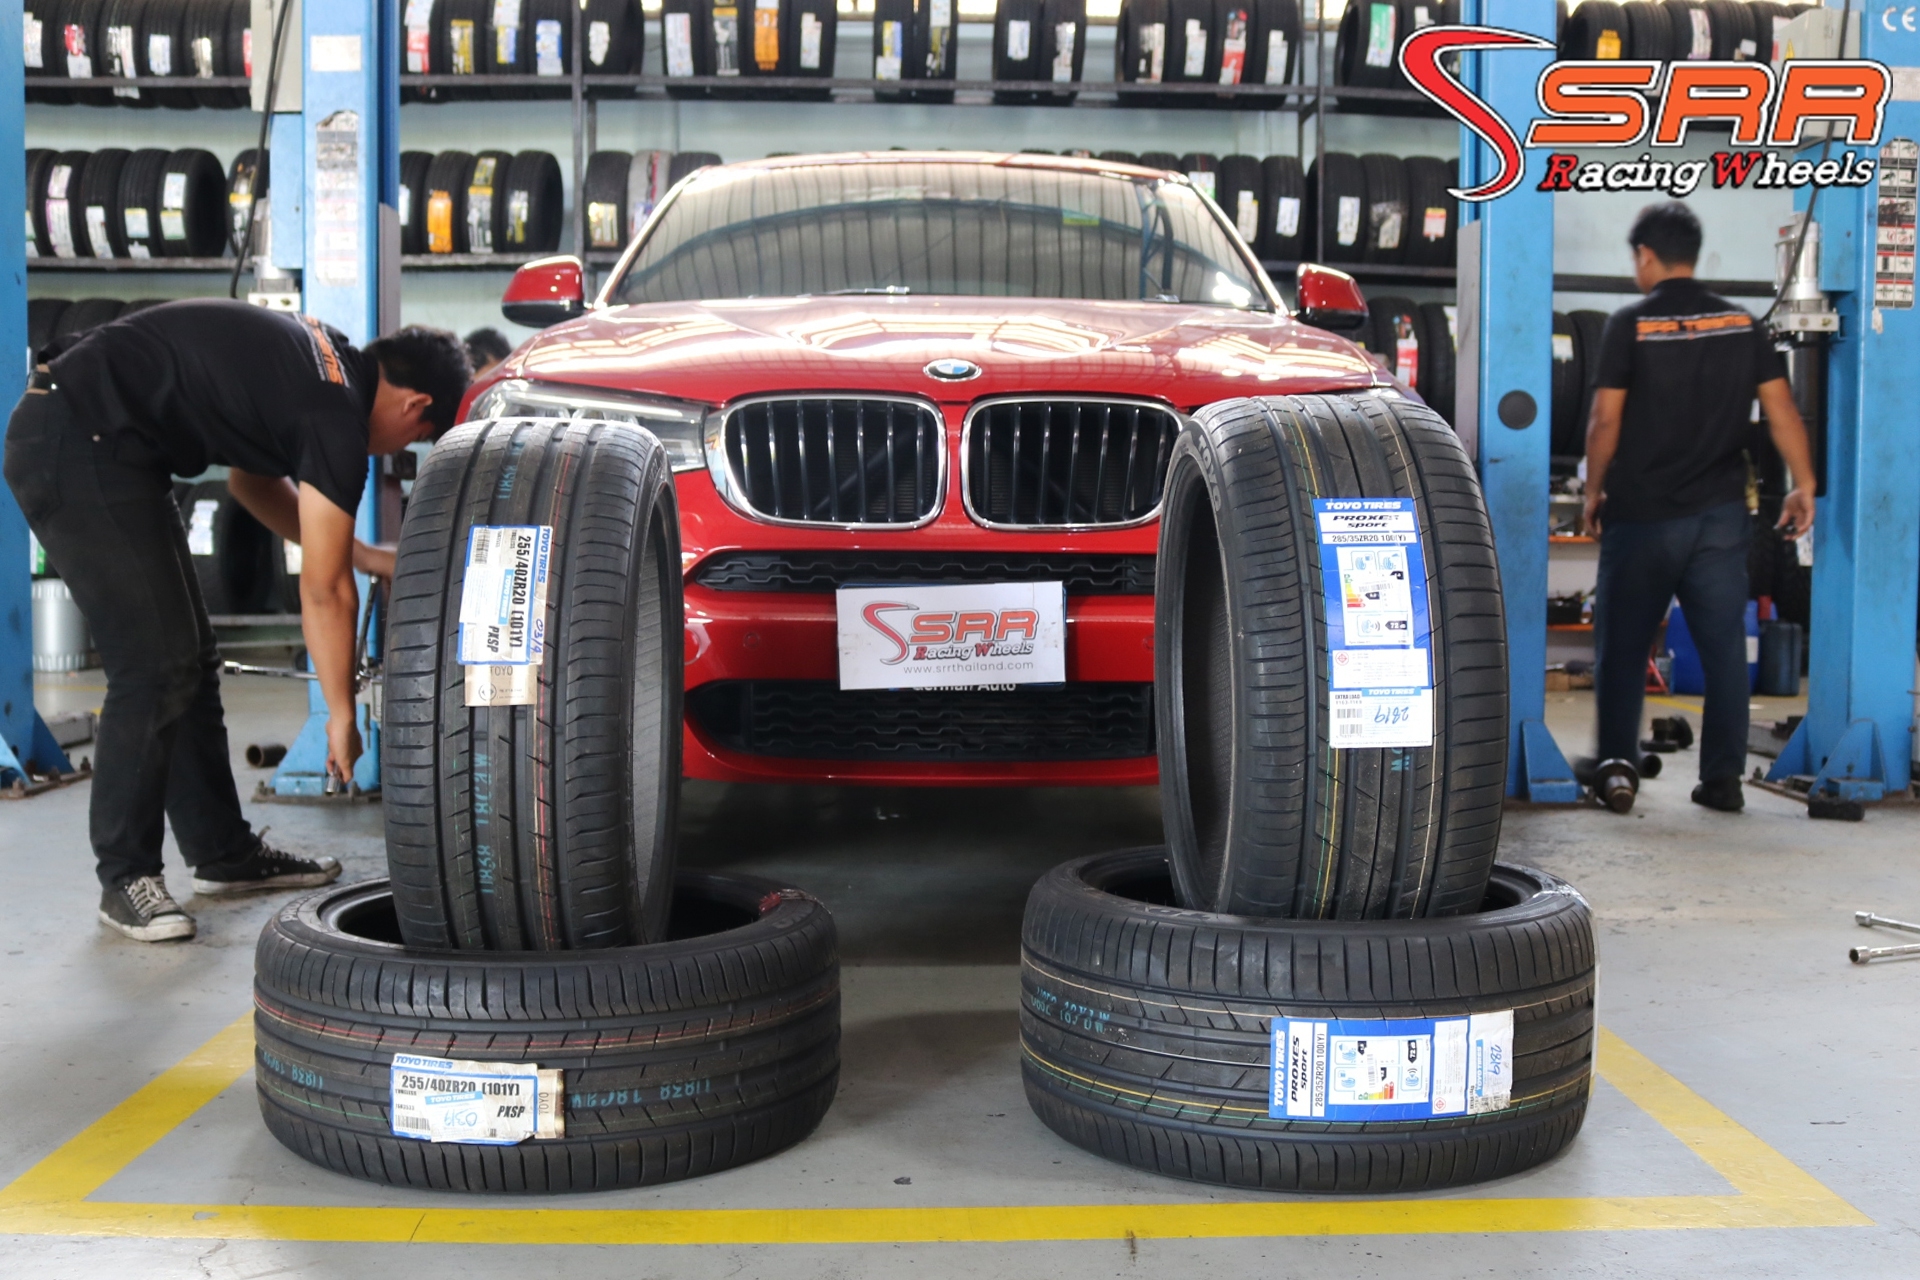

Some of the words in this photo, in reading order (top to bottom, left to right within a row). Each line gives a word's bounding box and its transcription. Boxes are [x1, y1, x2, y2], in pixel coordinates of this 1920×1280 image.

[1325, 501, 1361, 510] TOYO
[1363, 501, 1401, 510] TIRES
[541, 528, 551, 553] TOYO
[512, 536, 532, 605] 255/40ZR20
[537, 554, 548, 584] TIRES
[503, 574, 511, 594] TOYO
[500, 595, 509, 619] TIRES
[487, 626, 500, 653] PXSP
[913, 644, 974, 661] Racing
[974, 641, 1034, 657] Wheels
[903, 661, 1034, 675] www.srrthailand.com
[1275, 1030, 1286, 1069] TIRES
[1316, 1033, 1325, 1058] 100(Y)
[396, 1055, 422, 1066] TOYO
[422, 1059, 453, 1069] TIRES
[1291, 1035, 1299, 1102] PROXES
[1300, 1048, 1308, 1090] sport
[402, 1075, 476, 1093] 255/40ZR20
[1274, 1070, 1284, 1106] TOYO
[1315, 1060, 1325, 1107] 285/35ZR20
[497, 1105, 525, 1119] PXSP
